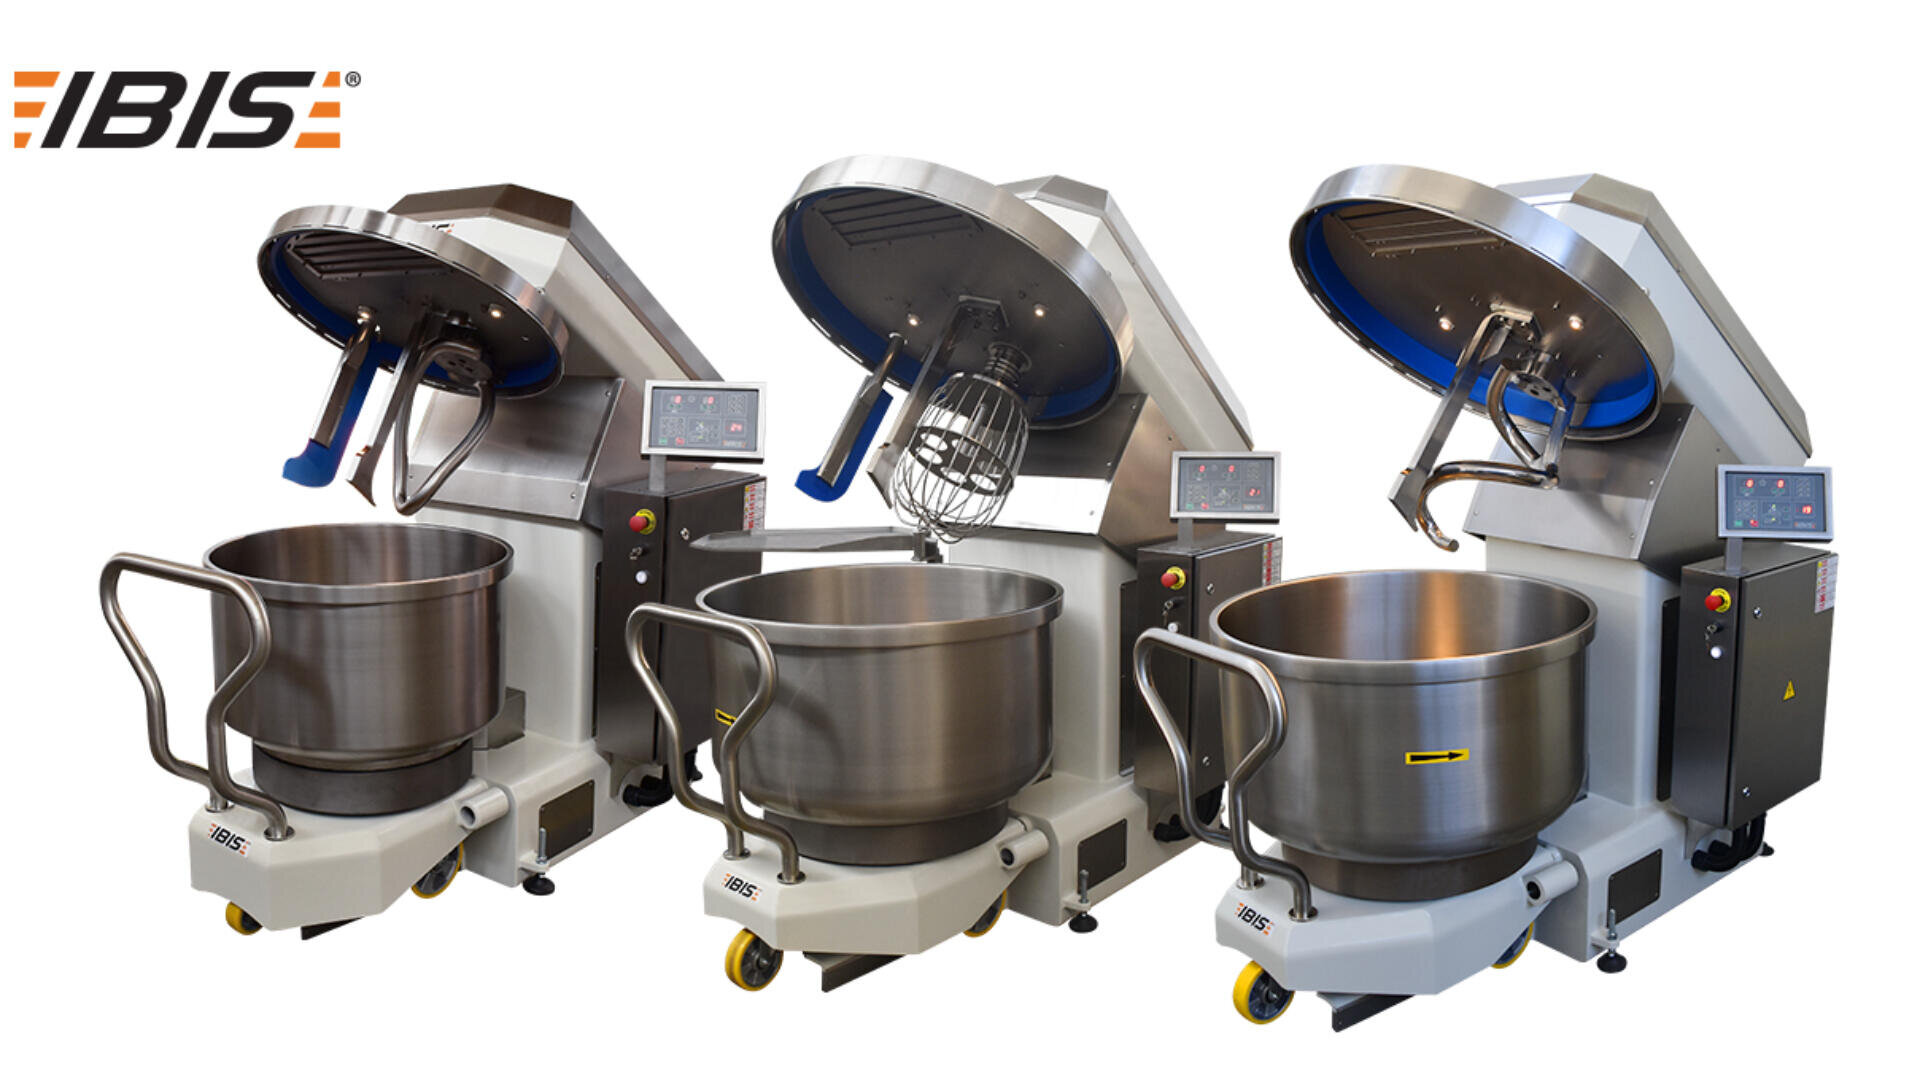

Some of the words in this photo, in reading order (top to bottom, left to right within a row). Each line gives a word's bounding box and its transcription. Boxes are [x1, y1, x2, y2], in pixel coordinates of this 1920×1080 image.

[210, 826, 246, 851] IBIS
[724, 875, 757, 898] IBIS
[1237, 905, 1270, 931] IBIS
